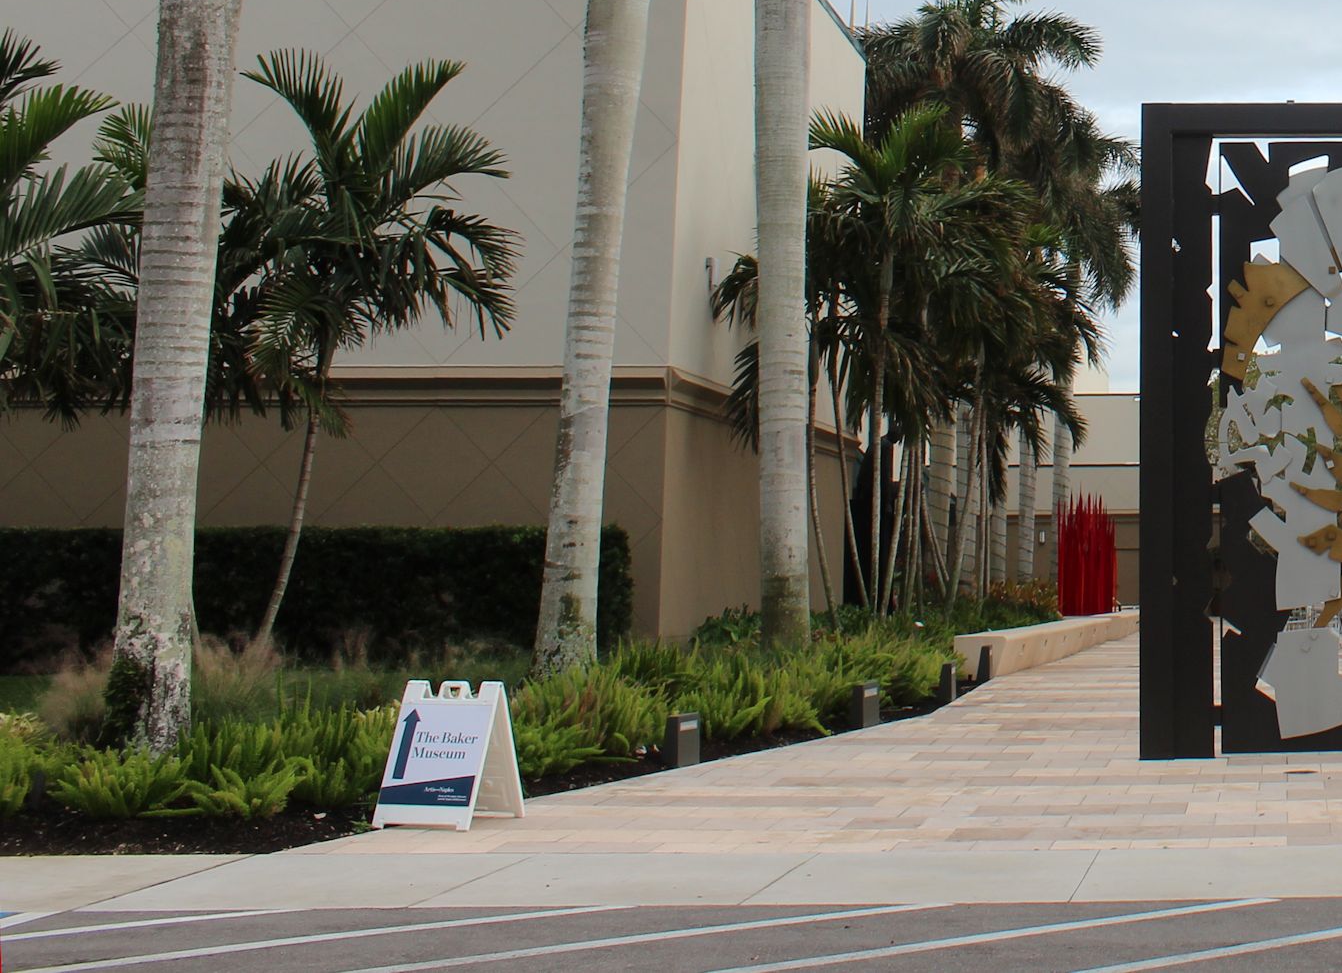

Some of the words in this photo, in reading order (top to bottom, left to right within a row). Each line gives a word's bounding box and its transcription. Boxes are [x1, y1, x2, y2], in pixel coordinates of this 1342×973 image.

[416, 731, 440, 744] The
[441, 731, 479, 744] Baker
[412, 746, 466, 759] Museum
